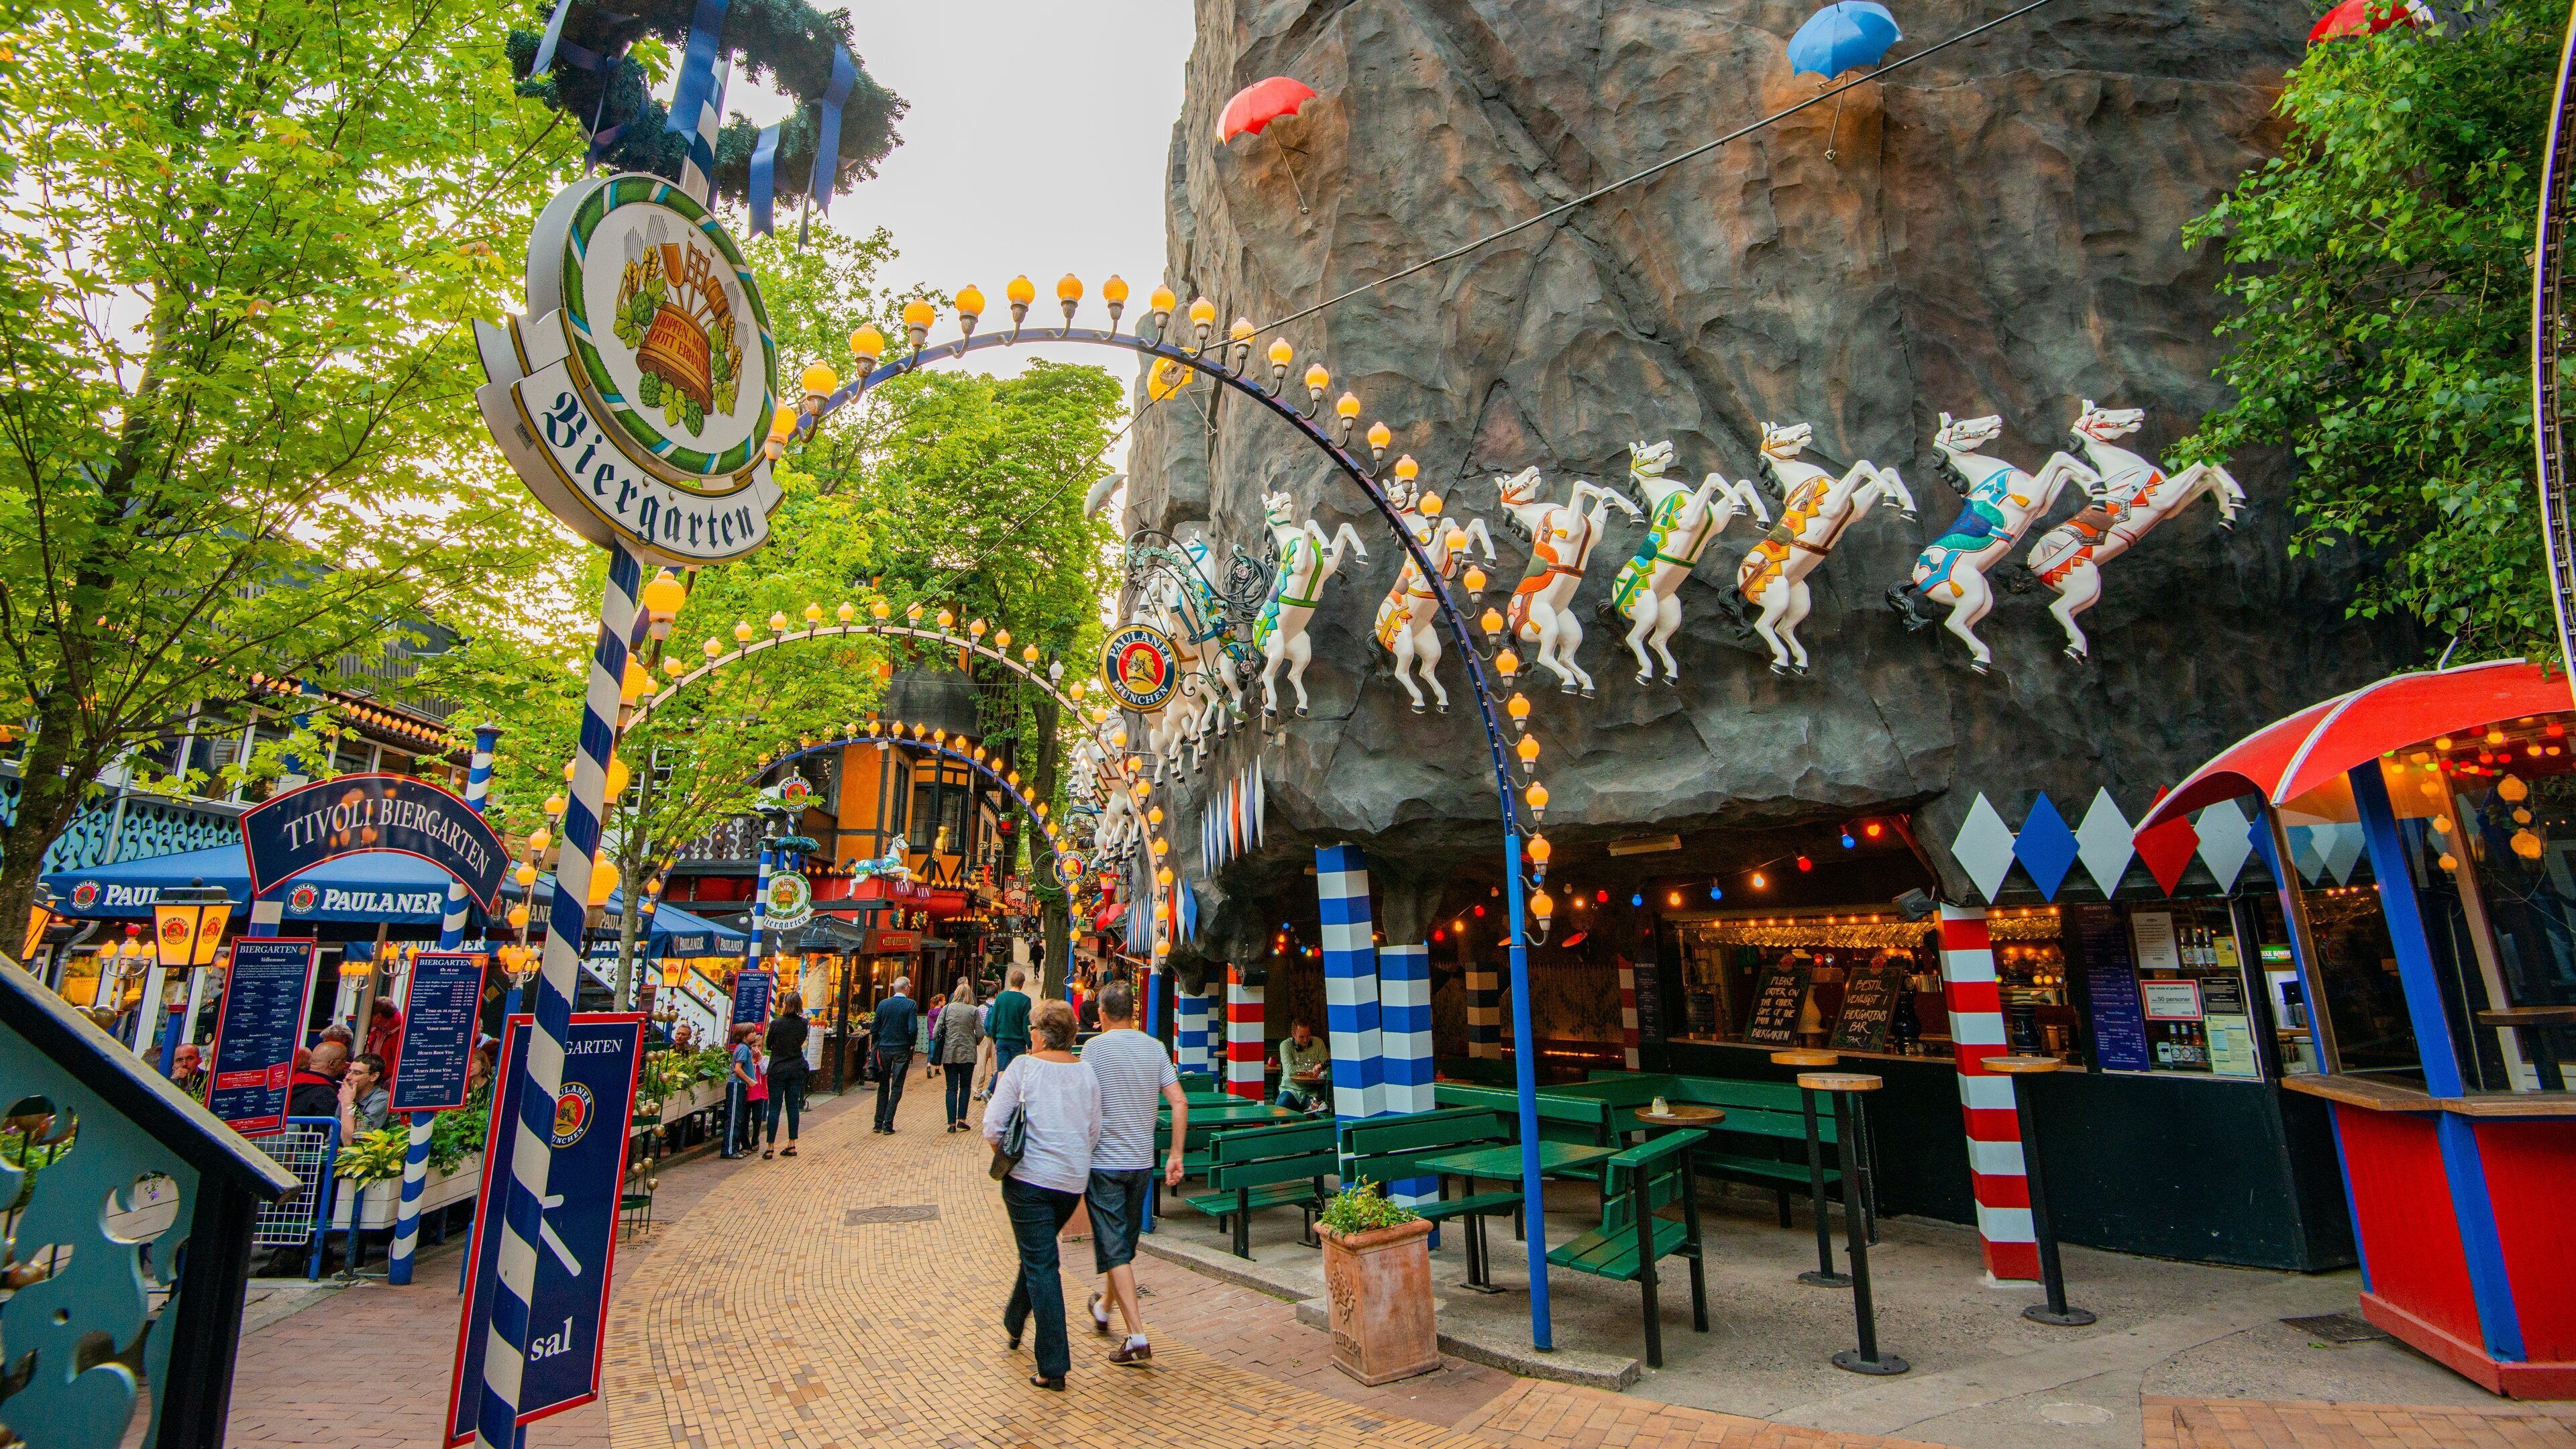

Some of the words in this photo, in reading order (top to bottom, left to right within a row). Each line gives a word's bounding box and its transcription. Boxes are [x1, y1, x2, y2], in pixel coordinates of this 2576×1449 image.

[650, 328, 677, 350] GOTT
[541, 392, 755, 550] Biergarten
[1108, 631, 1173, 665] PAULANER
[1112, 679, 1168, 704] MÜNCHEN
[782, 777, 811, 793] PAULANER
[283, 798, 374, 851] TIVOLI
[378, 798, 490, 879] BIERGARTEN
[72, 879, 101, 893] PAULANER
[290, 883, 319, 896] PAULANER
[896, 881, 910, 893] VIN
[103, 884, 160, 906] PAUL
[917, 888, 930, 898] VIN
[72, 900, 95, 911] MÜNCHEN
[321, 888, 443, 914] PAULANER
[289, 904, 313, 915] MÜNCHEN
[162, 918, 189, 930] PAULANER
[764, 915, 807, 930] iergarten
[239, 945, 298, 953] BIERGARTEN
[680, 936, 704, 952] PAULANER
[719, 938, 744, 953] PAULANER
[1770, 976, 1795, 986] PLEASE
[1855, 979, 1886, 991] BESTIL
[1765, 987, 1787, 997] ORDER
[1788, 988, 1801, 997] ON
[1761, 998, 1772, 1007] THE
[1775, 998, 1795, 1008] OTHER
[1847, 994, 1880, 1004] VENLIGST
[1757, 1007, 1771, 1016] SIDE
[1773, 1008, 1781, 1016] OF
[1784, 1009, 1795, 1018] THE
[1844, 1009, 1888, 1022] BIERGARTENS
[1755, 1017, 1770, 1025] PATH
[1774, 1018, 1784, 1026] IN
[1848, 1022, 1872, 1034] BAR
[1751, 1026, 1790, 1040] BIERGARTEN
[558, 1085, 591, 1106] ULANER
[552, 1126, 584, 1144] ÜNCHEN
